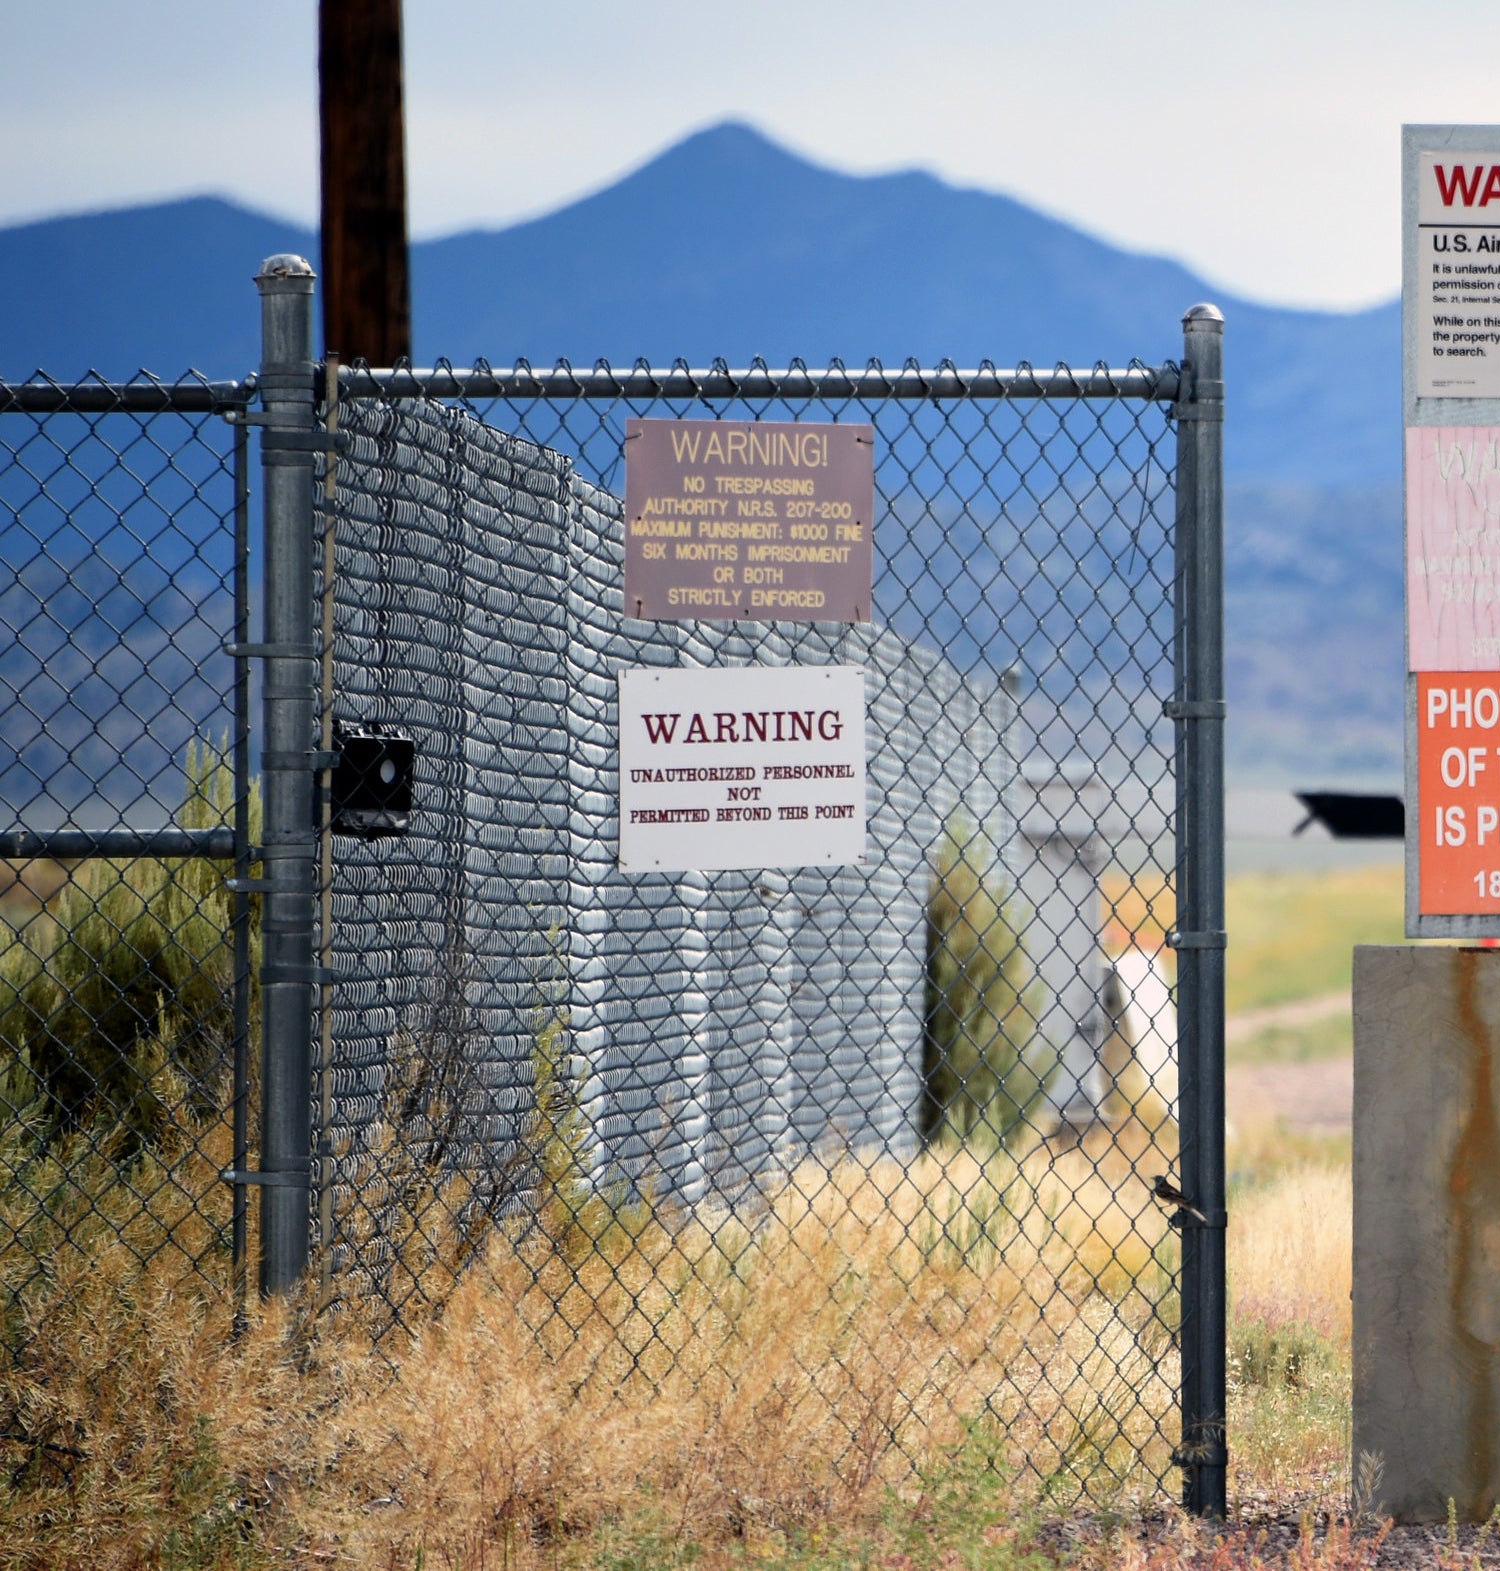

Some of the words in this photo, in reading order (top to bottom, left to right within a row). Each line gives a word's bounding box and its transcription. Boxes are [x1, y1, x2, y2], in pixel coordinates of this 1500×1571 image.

[1433, 235, 1470, 253] U.S.
[1433, 264, 1440, 273] It
[1443, 264, 1451, 273] is
[1455, 265, 1500, 274] unlawful
[1433, 280, 1494, 291] permission
[1433, 316, 1463, 326] While
[1467, 318, 1480, 327] on
[1433, 331, 1449, 341] the
[1453, 333, 1500, 344] property
[1433, 346, 1443, 356] to
[1447, 347, 1486, 357] search.
[671, 430, 828, 467] WARNING!
[684, 477, 704, 492] NO
[716, 477, 814, 496] TRESPASSING
[644, 498, 727, 516] AUTHORITY
[738, 501, 776, 517] N.R.S.
[786, 502, 851, 519] 207-200
[631, 520, 691, 537] MAXIMUM
[700, 522, 782, 539] PUNISHMENT:
[790, 523, 828, 540] $1000
[835, 525, 863, 541] FINE
[643, 543, 666, 560] SIX
[676, 544, 738, 561] MONTHS
[749, 546, 851, 563] IMPRISONMENT
[714, 567, 734, 583] OR
[744, 567, 783, 584] BOTH
[668, 589, 743, 606] STRICTLY
[752, 590, 825, 608] ENFORCED
[641, 710, 844, 744] WARNING
[630, 767, 755, 783] UNAUTHORIZED
[763, 764, 854, 780] PERSONNEL
[1440, 747, 1486, 788] OF
[727, 787, 761, 801] NOT
[630, 809, 710, 824] PERMITTED
[716, 807, 771, 822] BEYOND
[778, 807, 808, 820] THIS
[815, 805, 854, 819] POINT
[1436, 806, 1466, 847] IS
